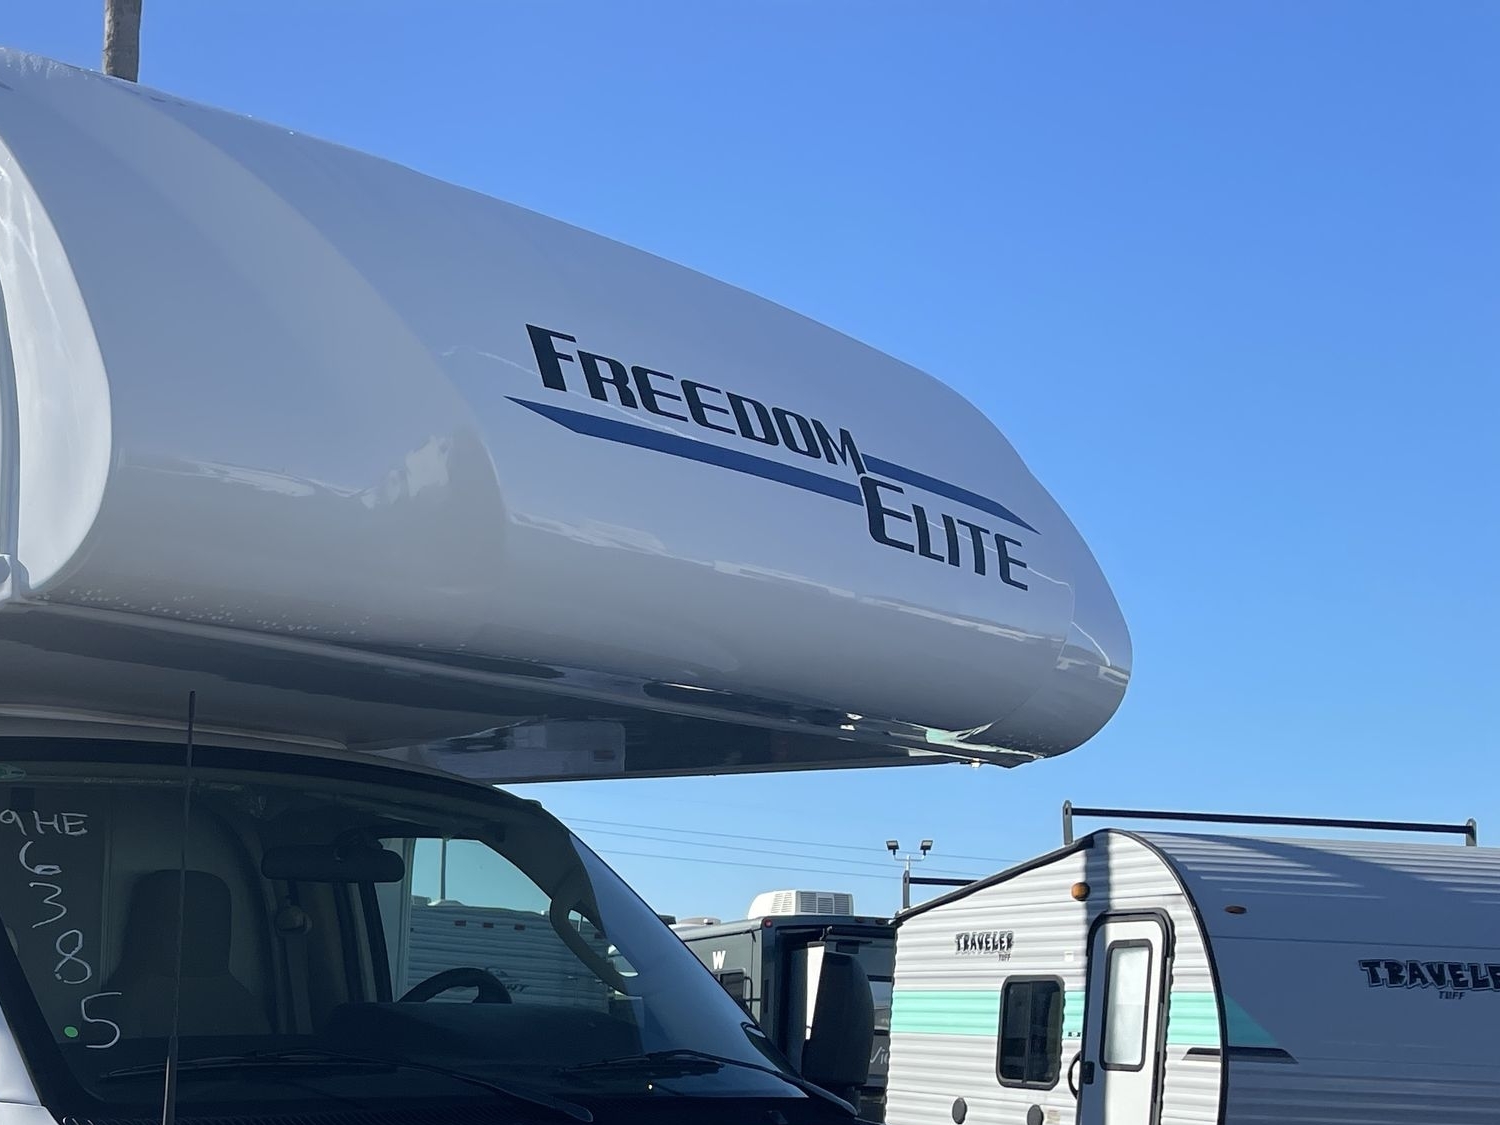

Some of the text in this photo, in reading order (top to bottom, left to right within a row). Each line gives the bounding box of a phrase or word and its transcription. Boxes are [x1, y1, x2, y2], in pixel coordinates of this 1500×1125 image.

[525, 323, 867, 475] FREEDOM
[860, 475, 1028, 591] ELITE
[712, 950, 726, 970] W
[955, 930, 1014, 954] TRAVELER
